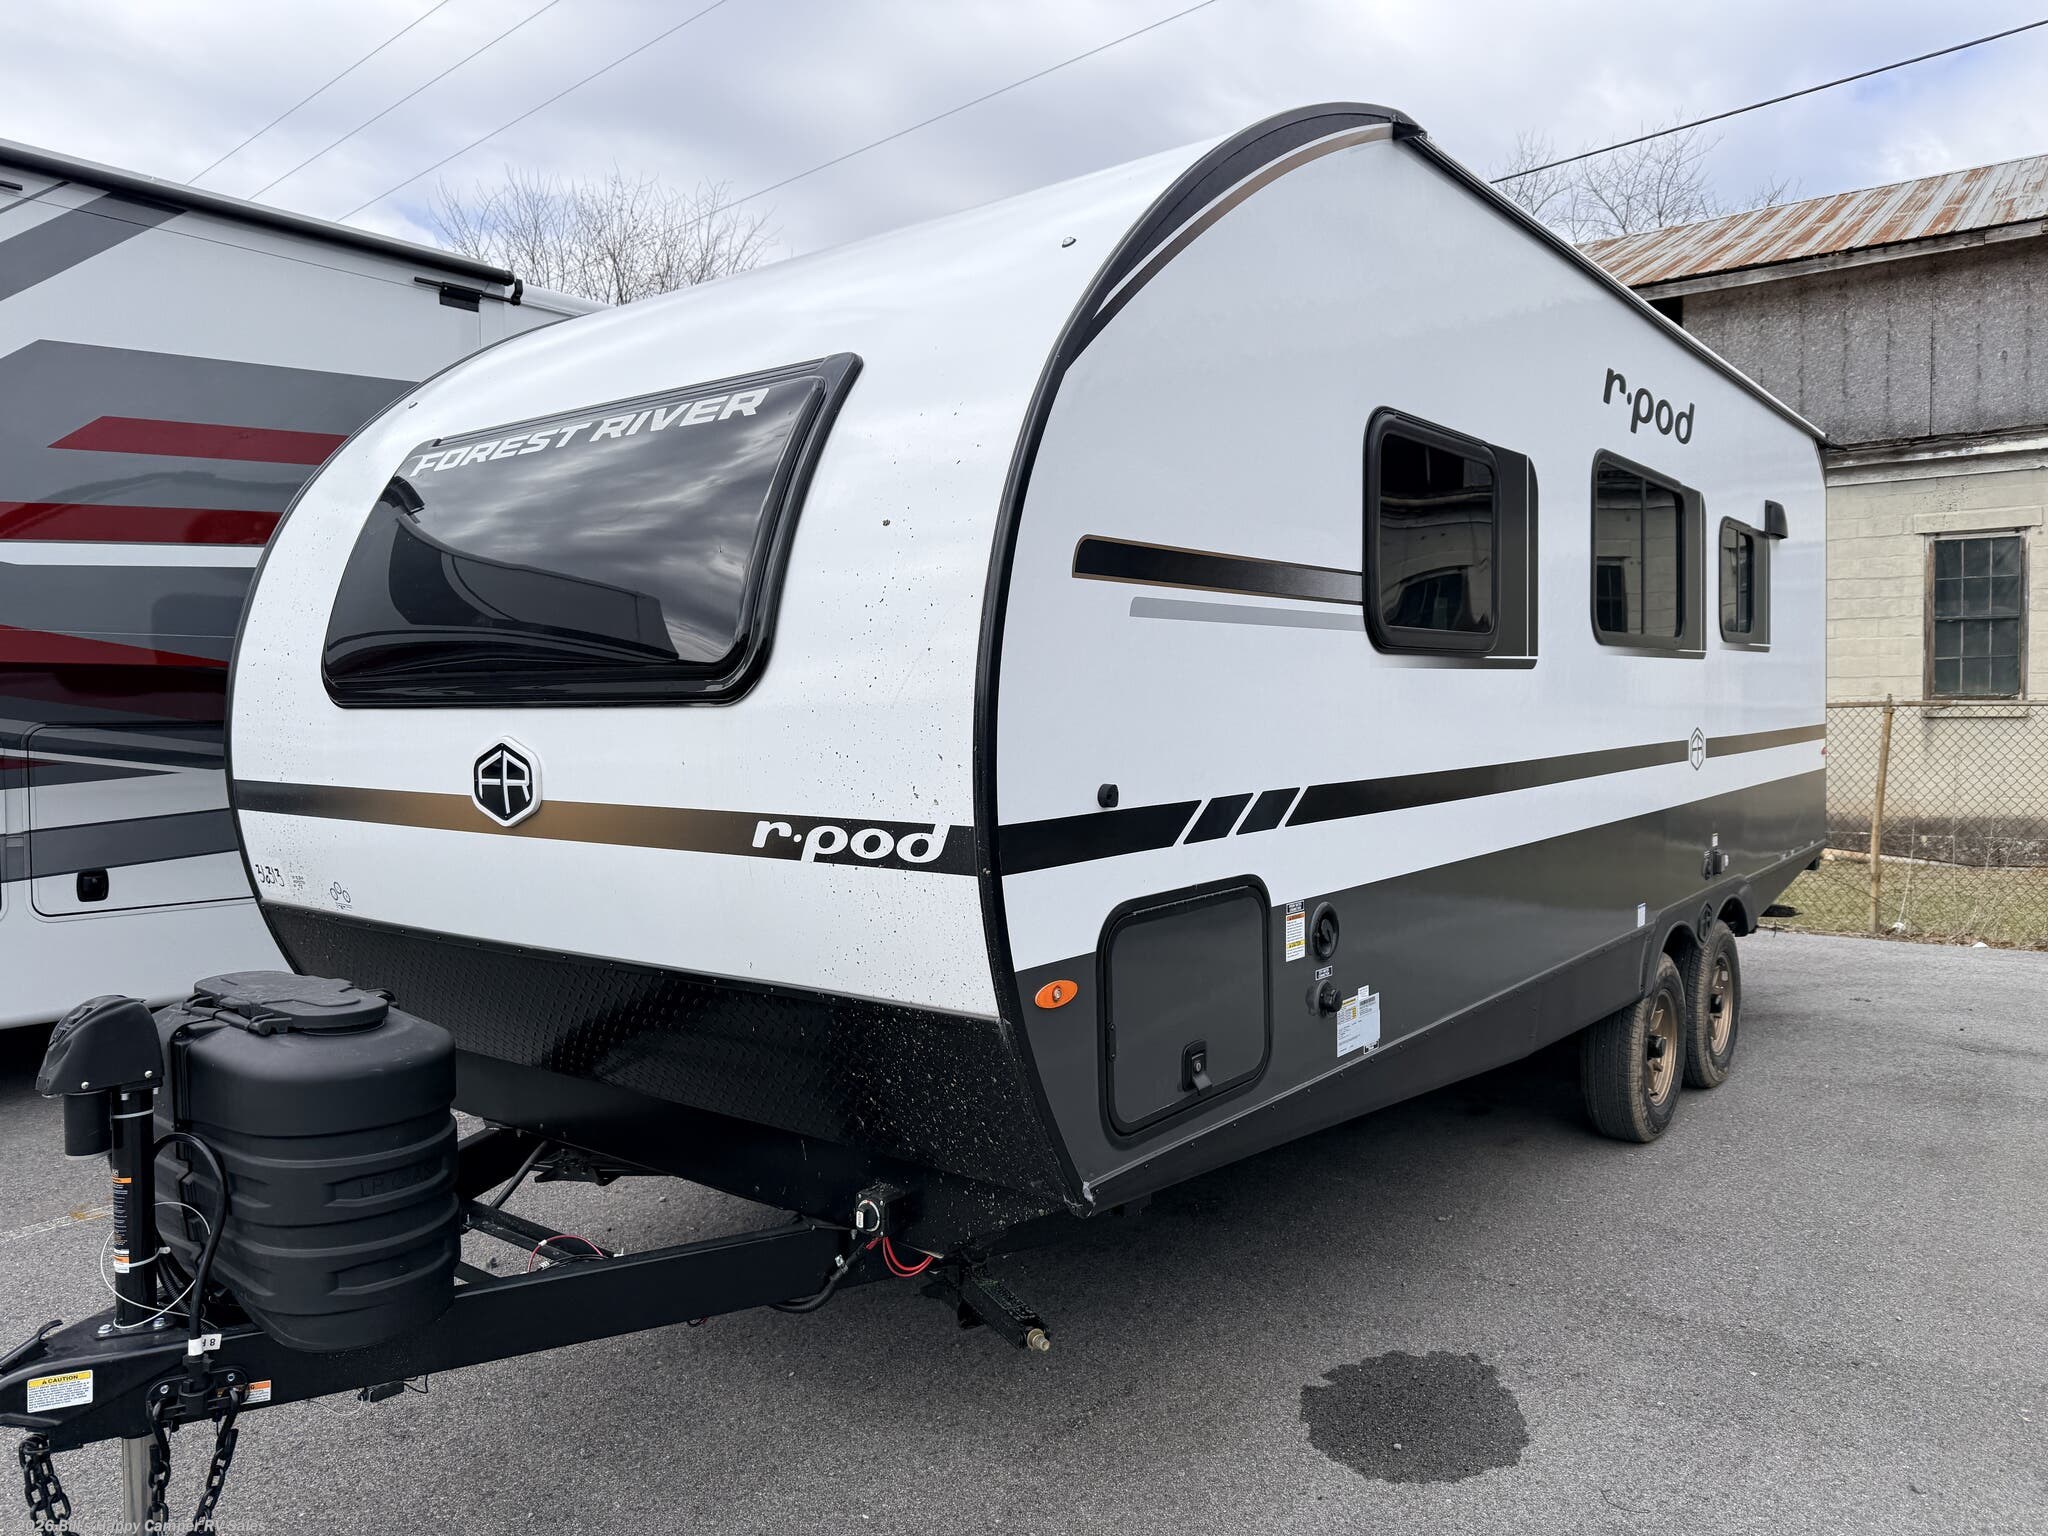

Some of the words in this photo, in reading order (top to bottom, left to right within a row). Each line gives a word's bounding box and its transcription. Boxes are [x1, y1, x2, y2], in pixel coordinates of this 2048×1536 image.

[409, 422, 592, 478] FOREST
[589, 387, 770, 442] RIVER
[47, 1374, 79, 1384] CAUTION
